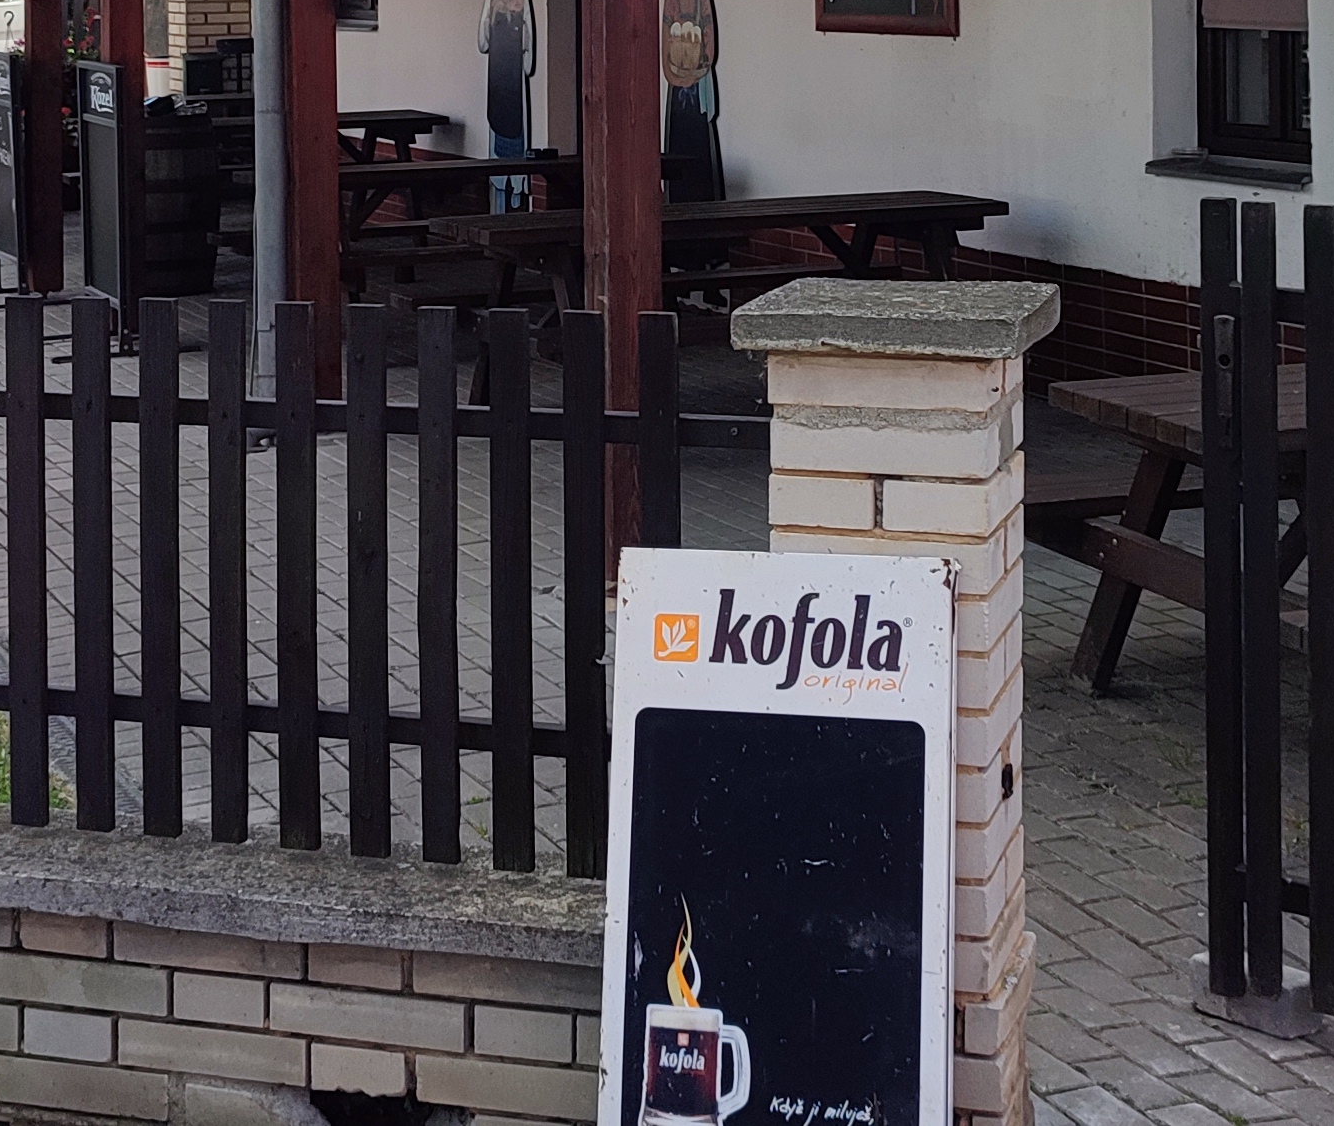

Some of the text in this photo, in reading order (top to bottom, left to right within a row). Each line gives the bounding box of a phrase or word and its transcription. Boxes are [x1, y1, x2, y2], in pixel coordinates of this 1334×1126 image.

[709, 589, 903, 690] kofola
[803, 663, 909, 705] original
[659, 1045, 705, 1074] kofola
